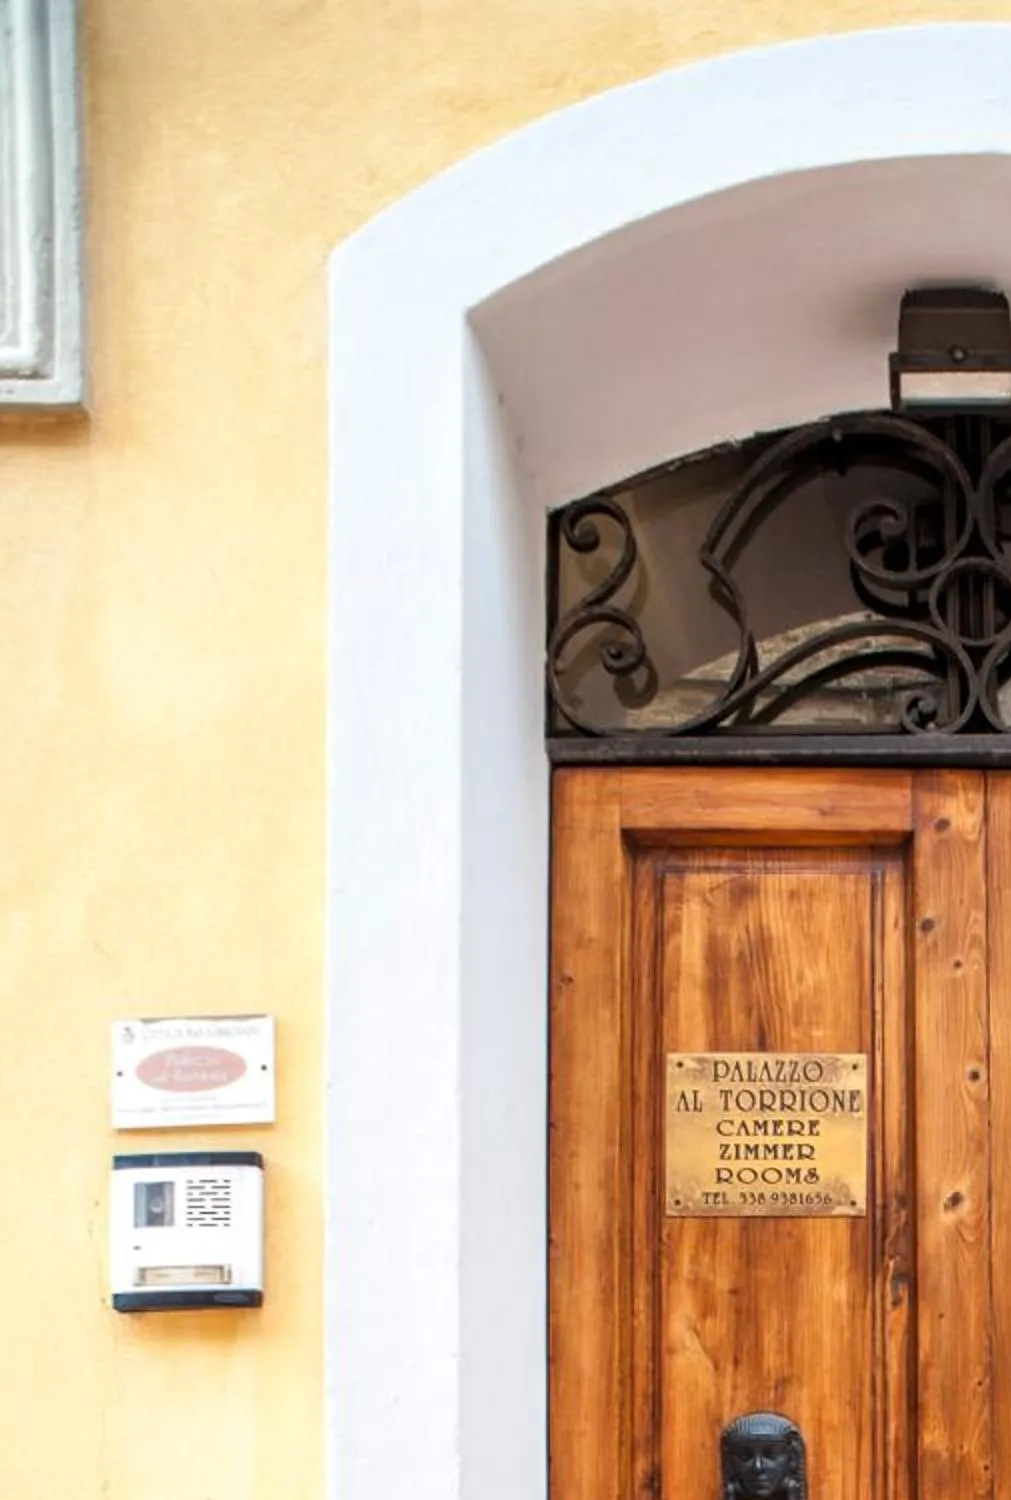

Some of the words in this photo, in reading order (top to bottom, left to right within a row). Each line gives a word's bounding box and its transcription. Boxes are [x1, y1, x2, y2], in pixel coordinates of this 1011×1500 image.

[712, 1060, 824, 1082] PALAZZO
[676, 1090, 704, 1112] AL
[720, 1090, 862, 1112] TORRIONE
[716, 1119, 820, 1137] CAMERE
[719, 1143, 815, 1161] ZIMMER
[715, 1167, 820, 1184] ROOMS
